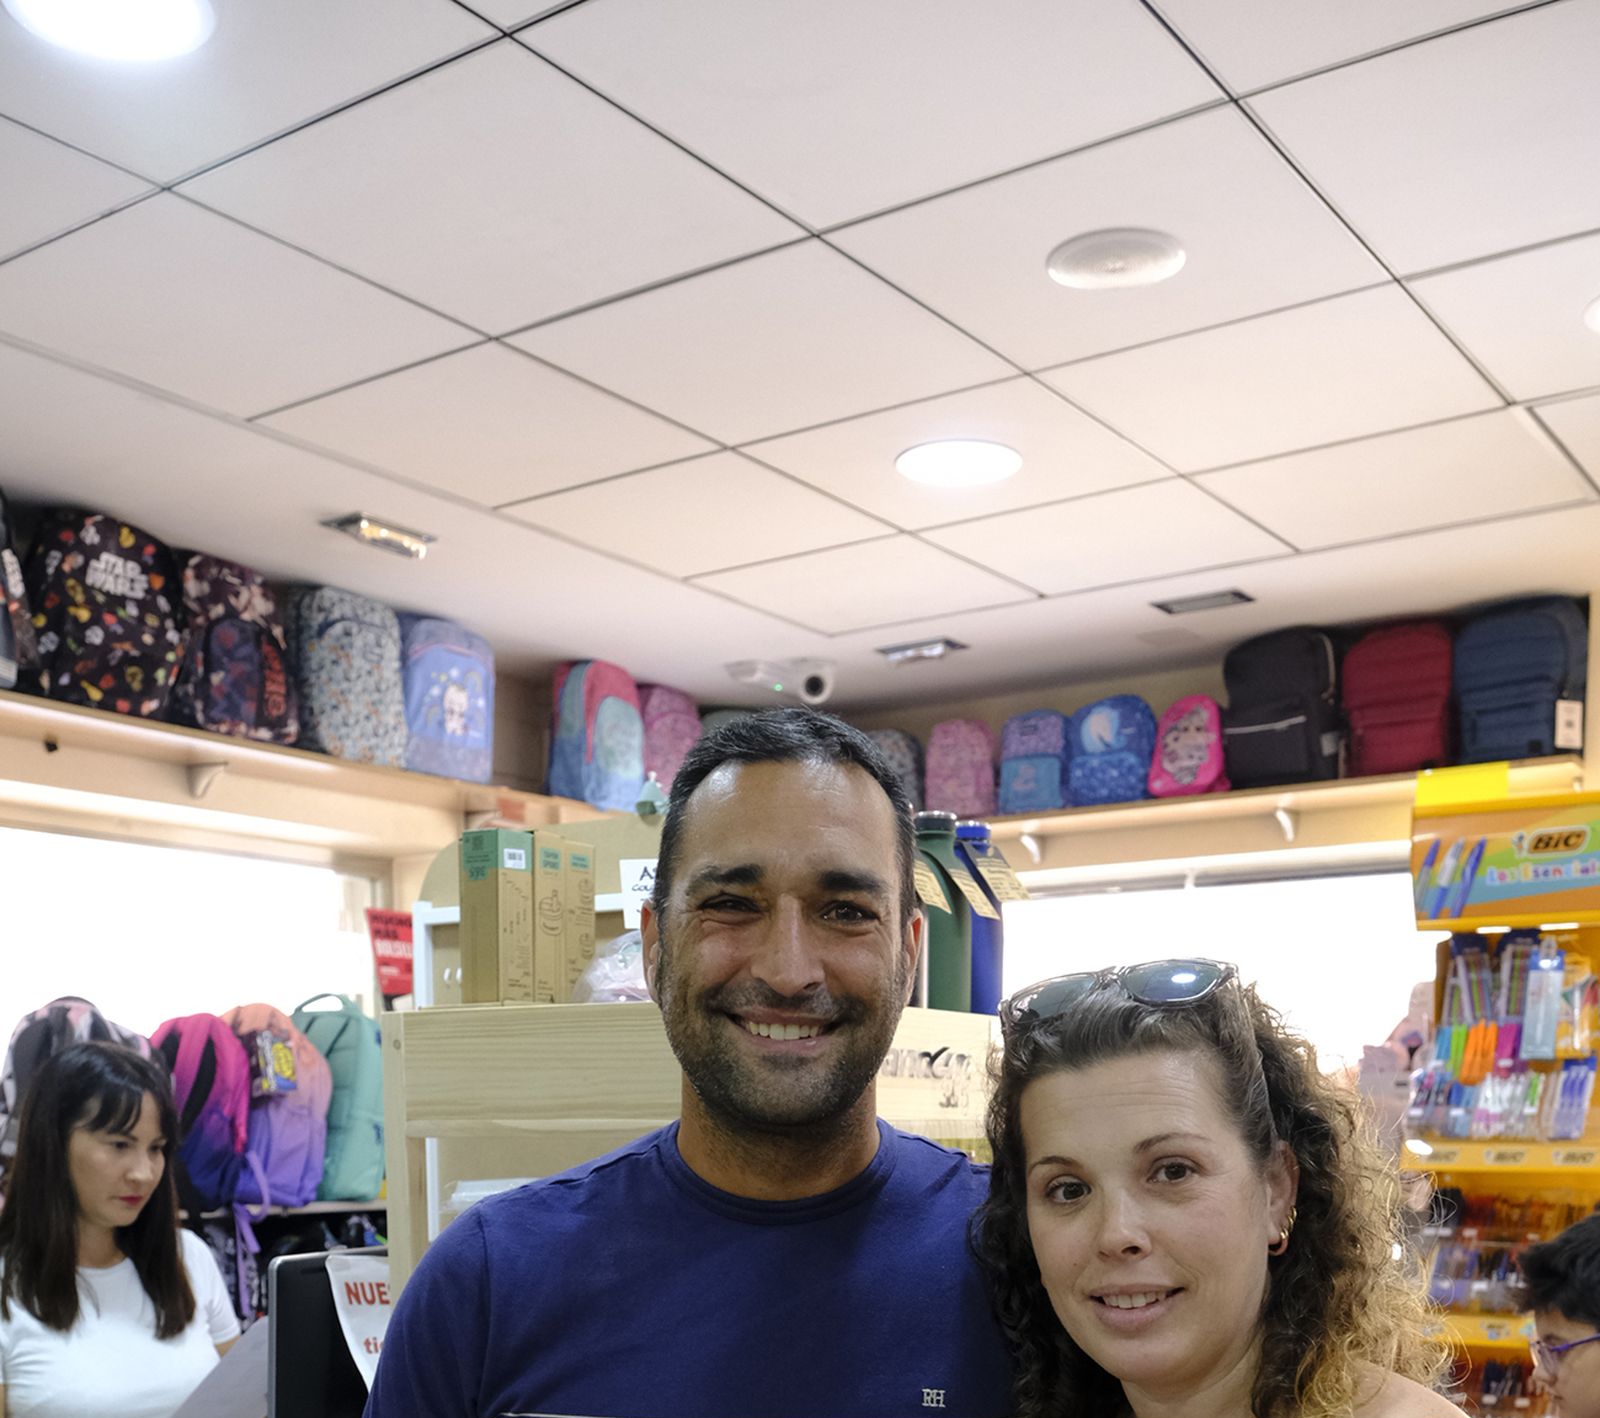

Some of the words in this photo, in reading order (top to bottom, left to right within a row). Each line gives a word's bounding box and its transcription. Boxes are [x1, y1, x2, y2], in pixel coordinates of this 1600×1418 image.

[91, 552, 141, 579] STAR
[86, 566, 148, 599] WARS
[344, 1280, 391, 1306] NUE
